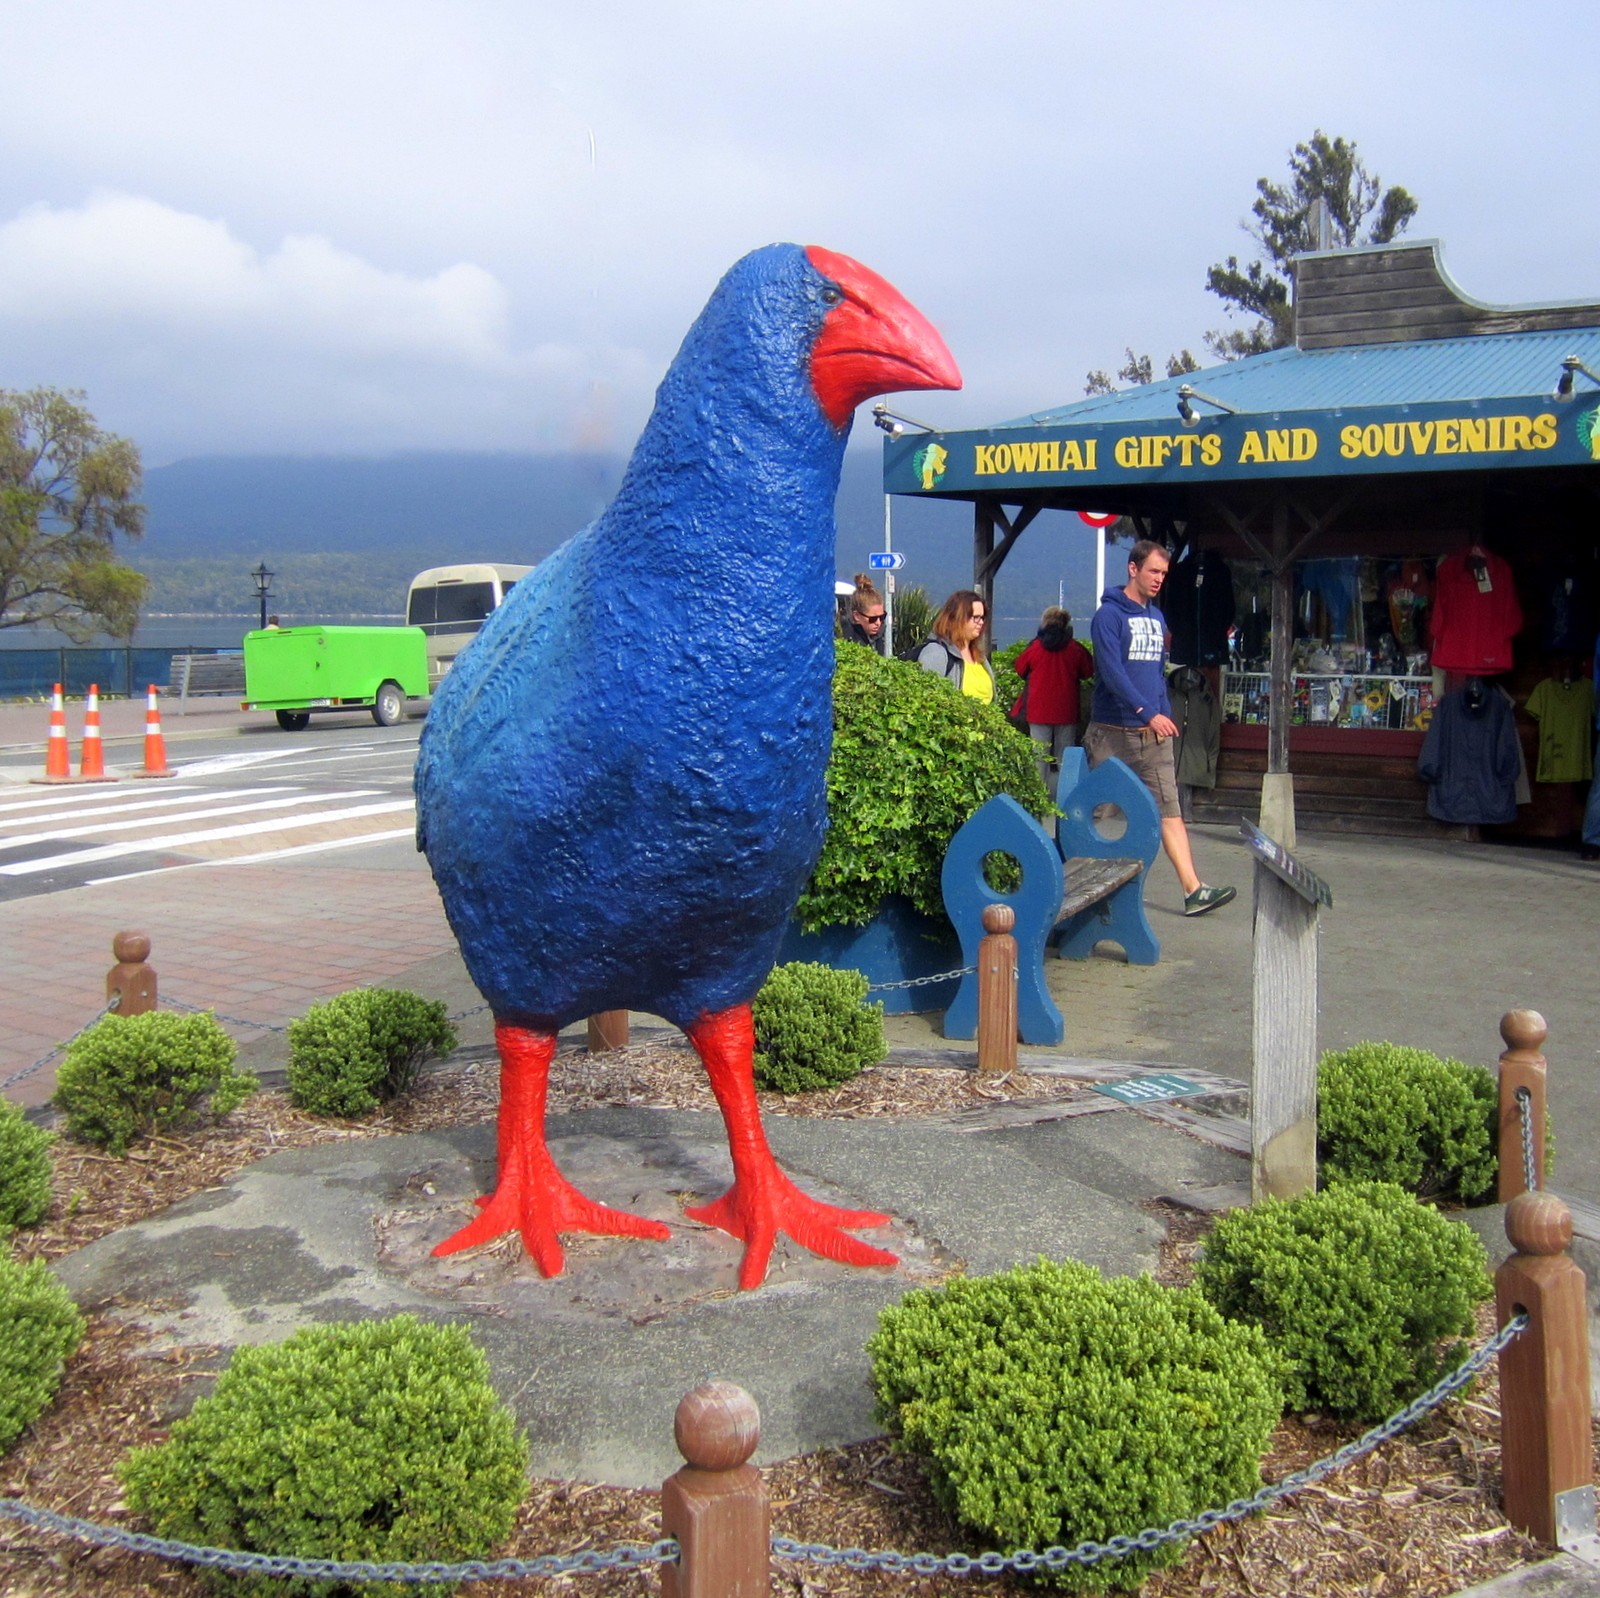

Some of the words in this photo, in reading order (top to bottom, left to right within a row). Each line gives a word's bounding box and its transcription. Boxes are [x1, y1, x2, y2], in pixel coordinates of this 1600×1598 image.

[974, 439, 1097, 475] KOWHAI
[1114, 433, 1222, 468] GIFTS
[1238, 428, 1318, 463] AND
[1340, 413, 1558, 459] SOUVENIRS
[1198, 889, 1212, 901] N
